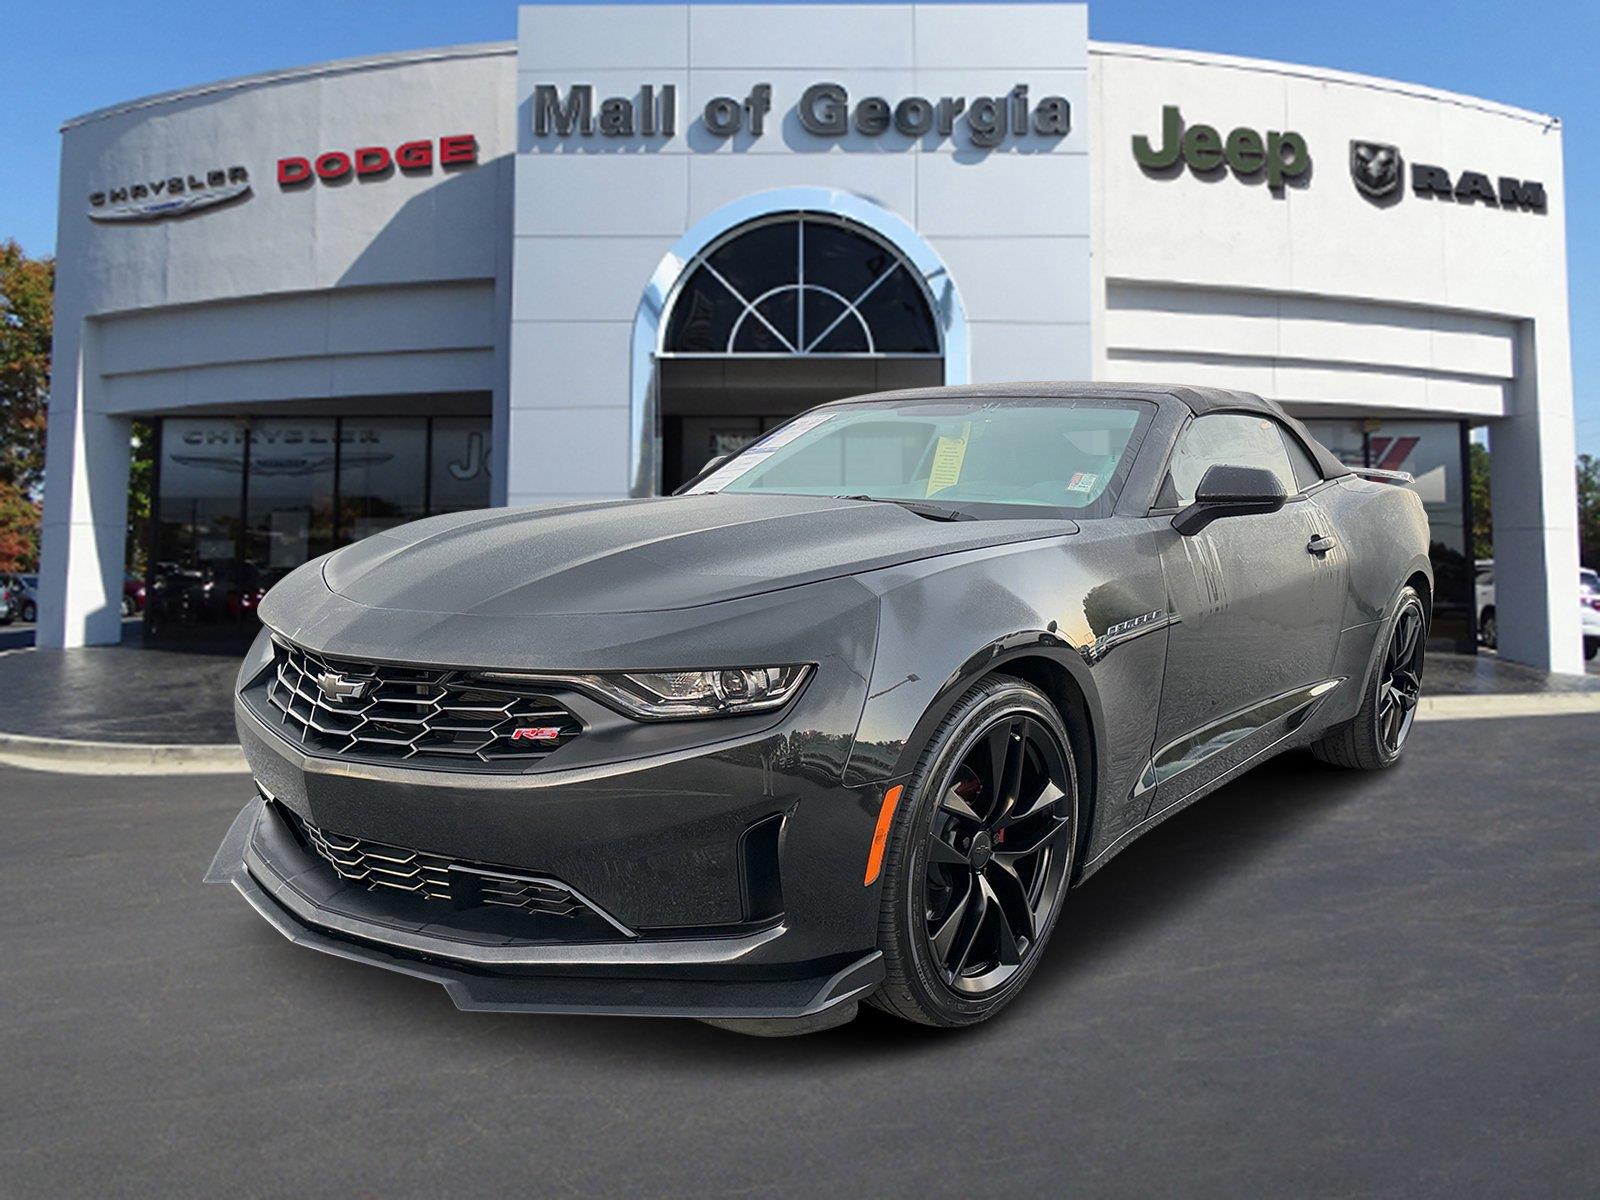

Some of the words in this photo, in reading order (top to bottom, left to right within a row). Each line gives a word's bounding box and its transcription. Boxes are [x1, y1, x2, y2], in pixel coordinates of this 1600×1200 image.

[534, 84, 676, 136] Mall
[705, 83, 771, 136] of
[800, 82, 1071, 148] Georgia
[277, 134, 477, 187] DODGE
[1132, 105, 1309, 188] Jeep
[90, 165, 249, 207] CHRYSLER
[1411, 162, 1547, 212] RAM
[511, 728, 560, 740] RS
